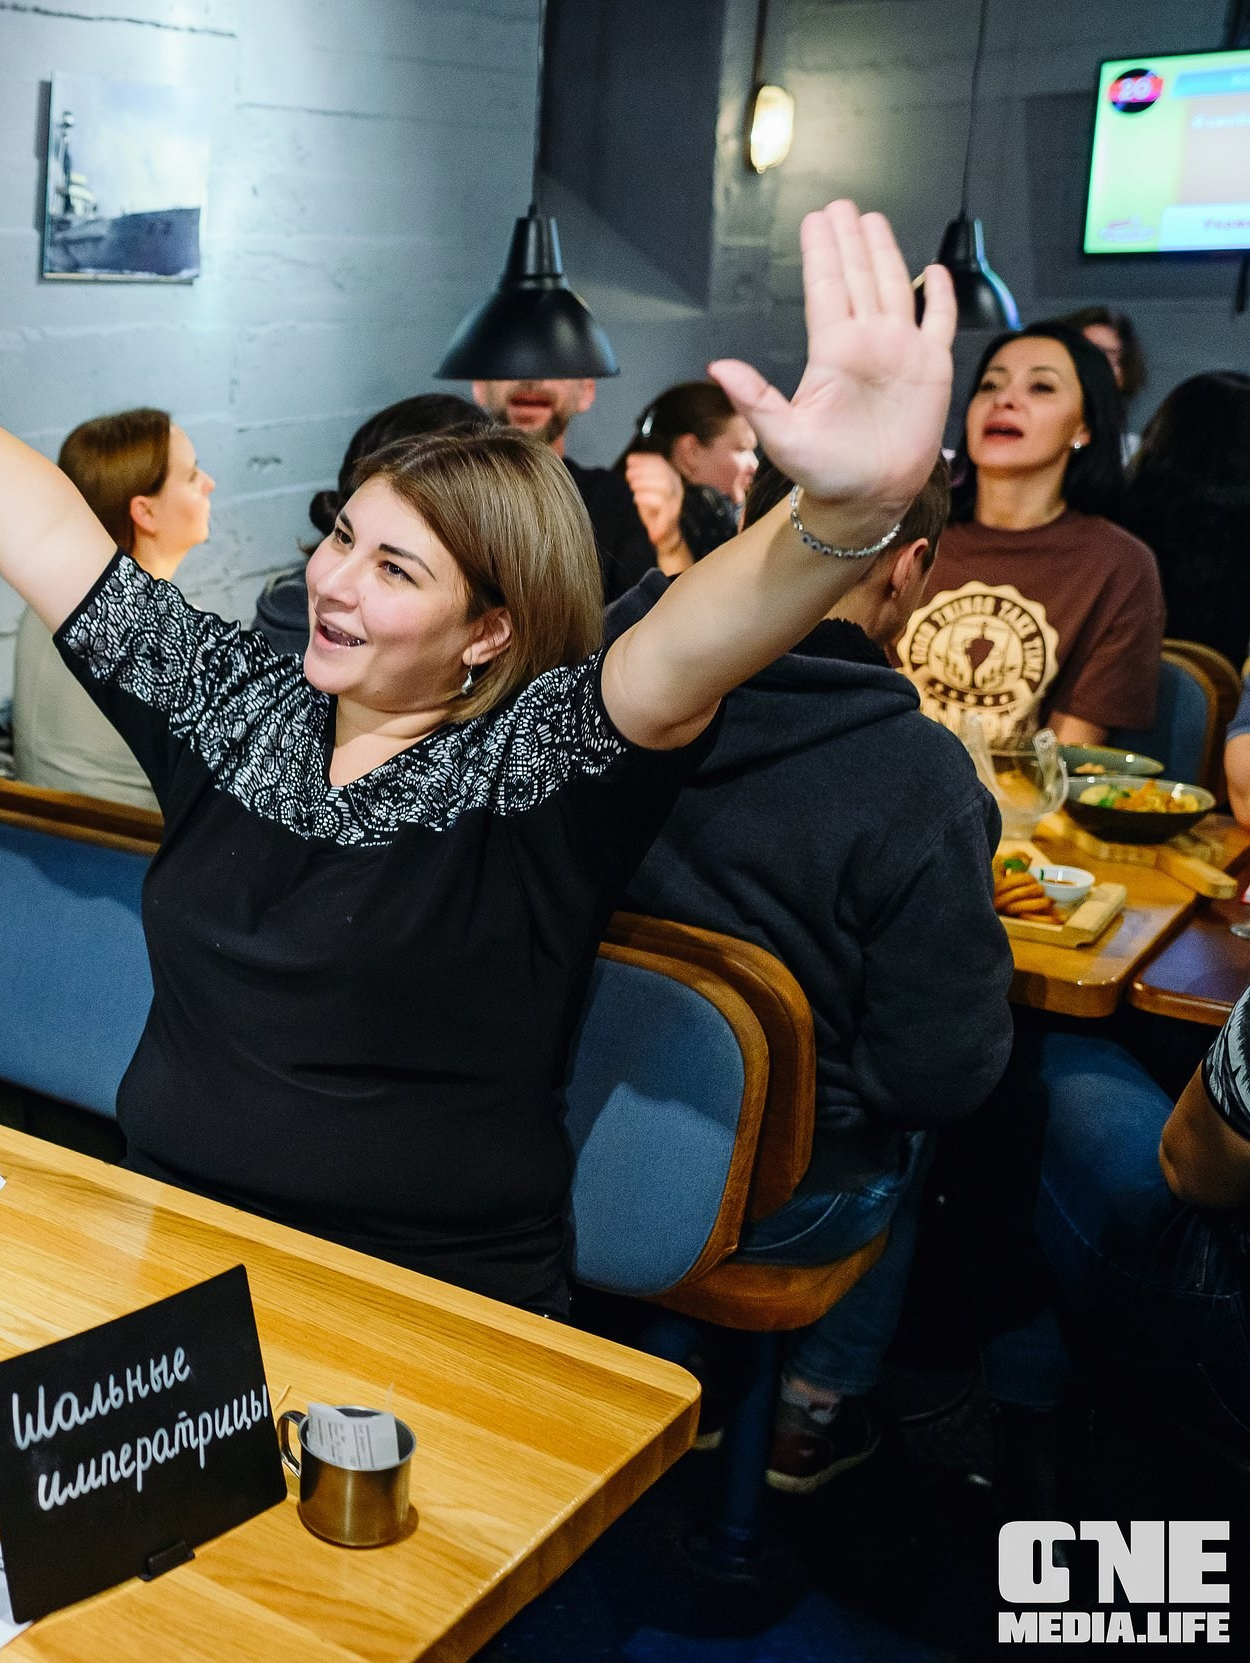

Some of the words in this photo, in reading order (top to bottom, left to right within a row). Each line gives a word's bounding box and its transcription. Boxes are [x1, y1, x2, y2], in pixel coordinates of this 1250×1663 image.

[998, 600, 1037, 639] TAKE
[12, 1346, 191, 1450] Шальные
[37, 1384, 268, 1512] императрицы
